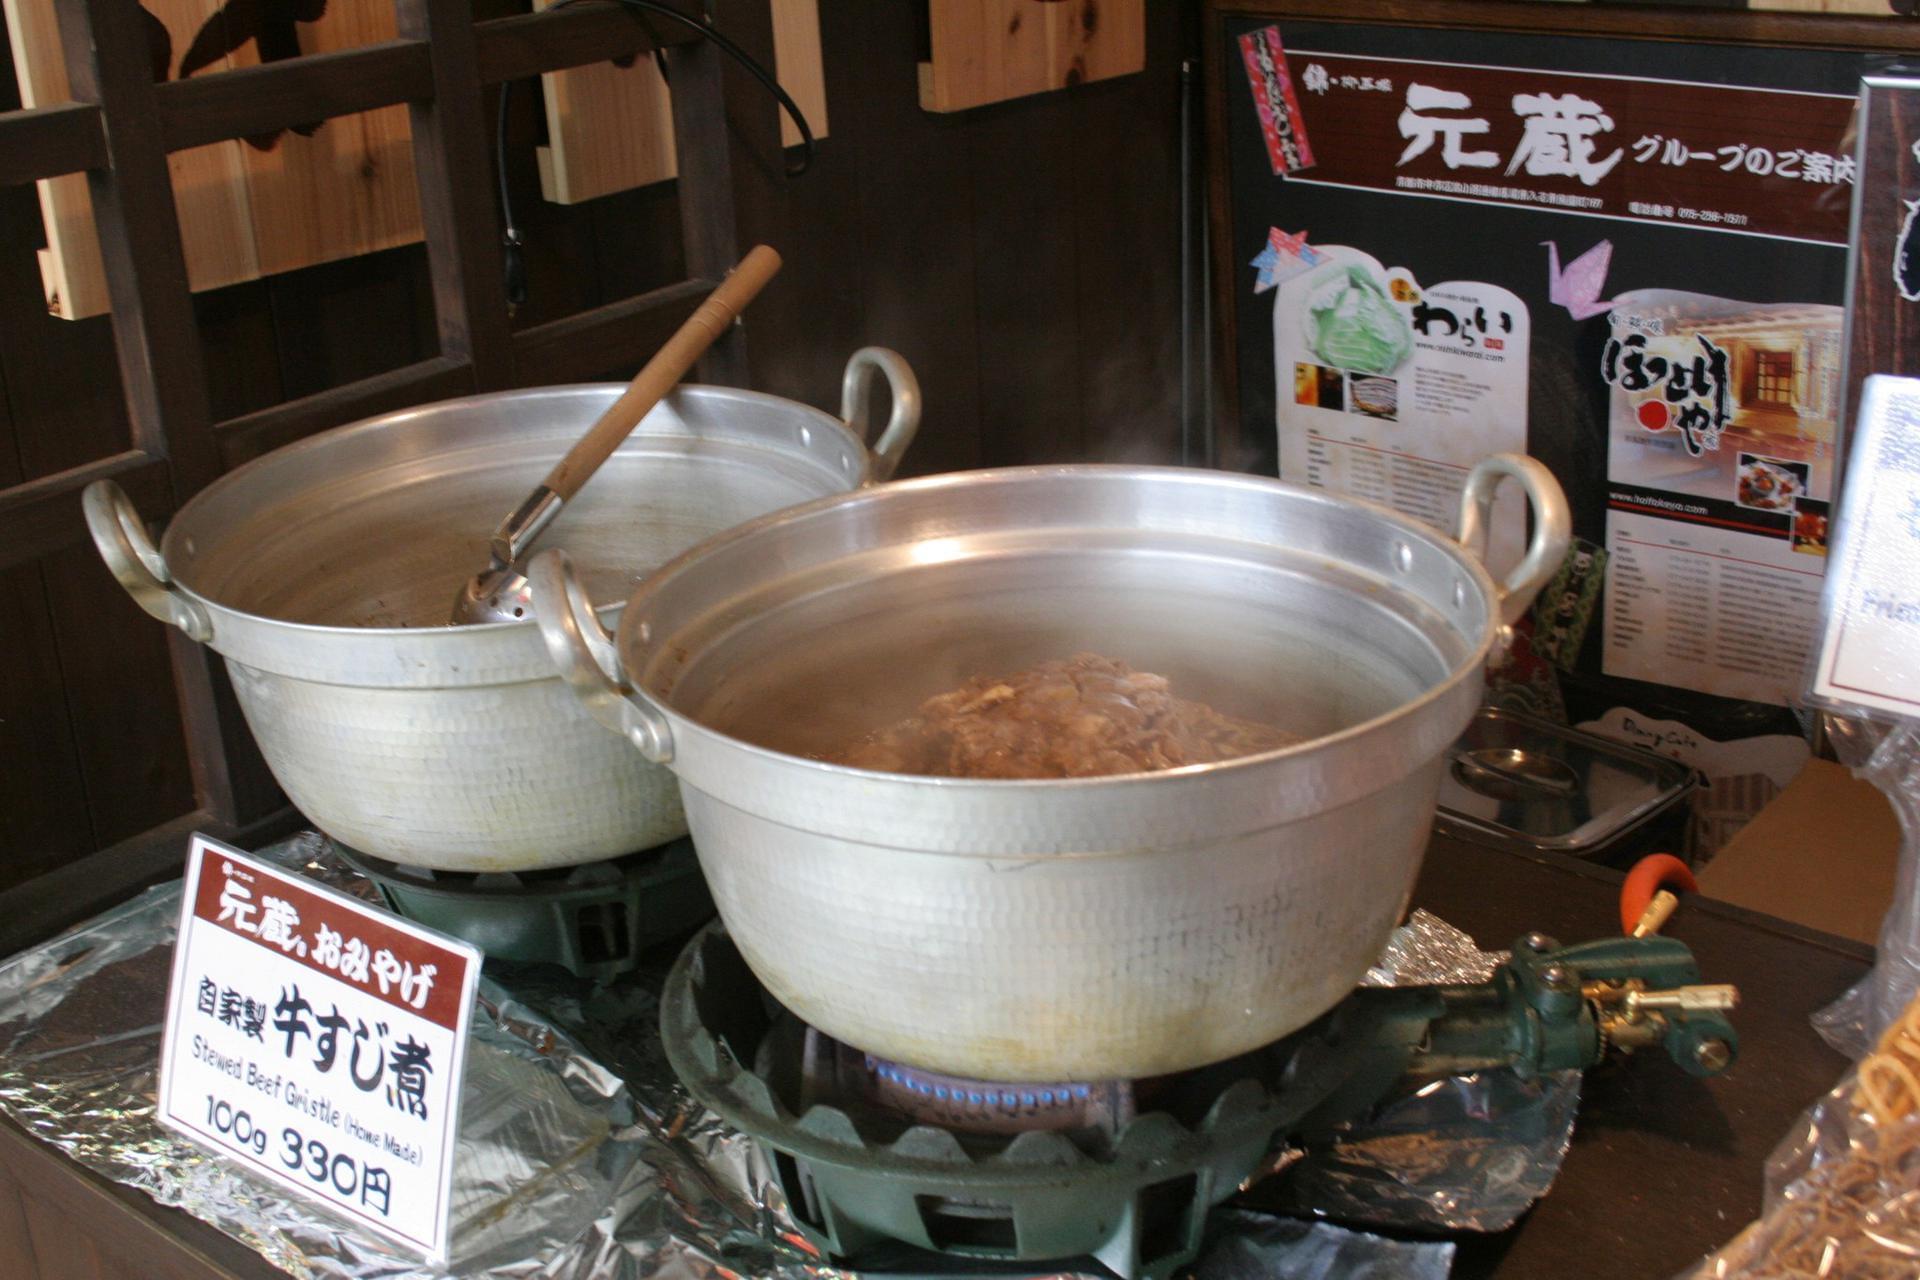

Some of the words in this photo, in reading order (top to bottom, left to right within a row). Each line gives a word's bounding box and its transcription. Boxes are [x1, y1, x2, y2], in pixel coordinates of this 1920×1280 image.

[1395, 82, 1624, 186] 元蔵
[191, 1034, 244, 1081] Stewed
[246, 1061, 282, 1099] Beef
[284, 1081, 341, 1129] Gristle
[197, 974, 267, 1044] 自家製
[273, 982, 434, 1121] 牛すじ煮
[206, 1094, 266, 1155] 100g
[279, 1127, 391, 1217] 330円
